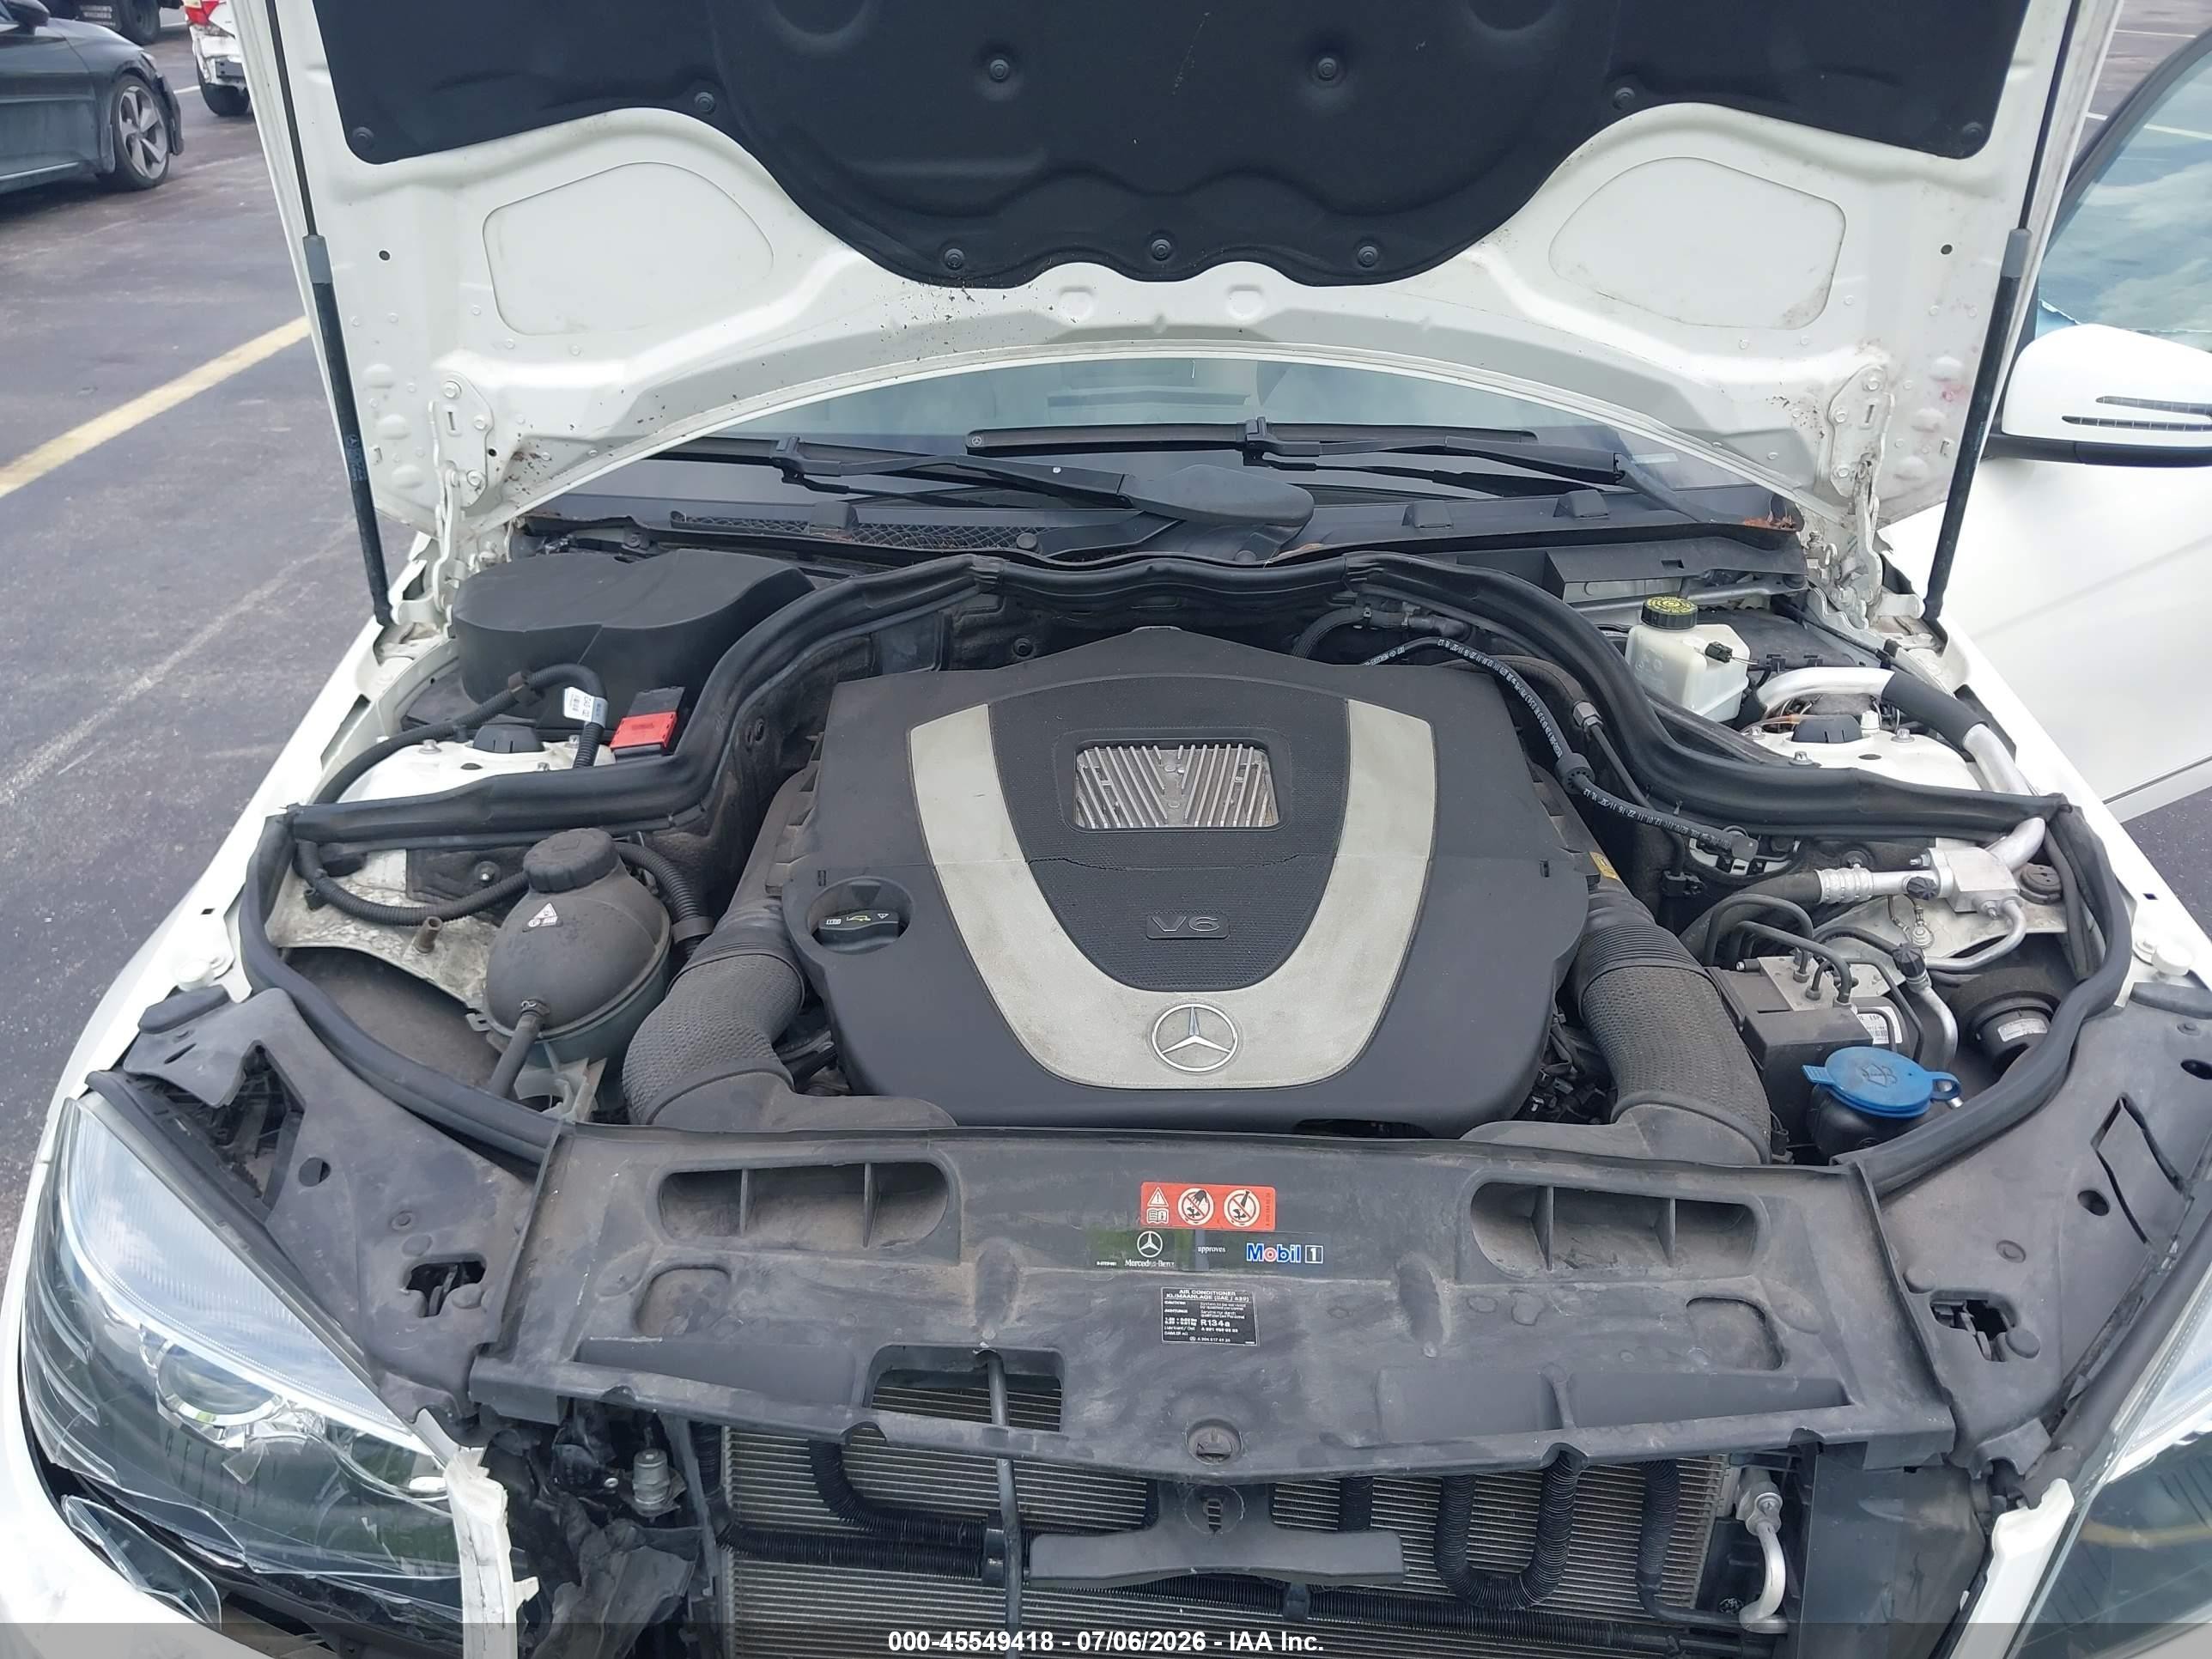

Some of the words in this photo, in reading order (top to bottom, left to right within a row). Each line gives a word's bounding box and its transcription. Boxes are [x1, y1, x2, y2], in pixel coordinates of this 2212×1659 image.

[1151, 915, 1220, 933] V6
[1197, 1245, 1226, 1254] approves
[1246, 1242, 1302, 1263] Mobil
[1200, 1319, 1231, 1328] R134a
